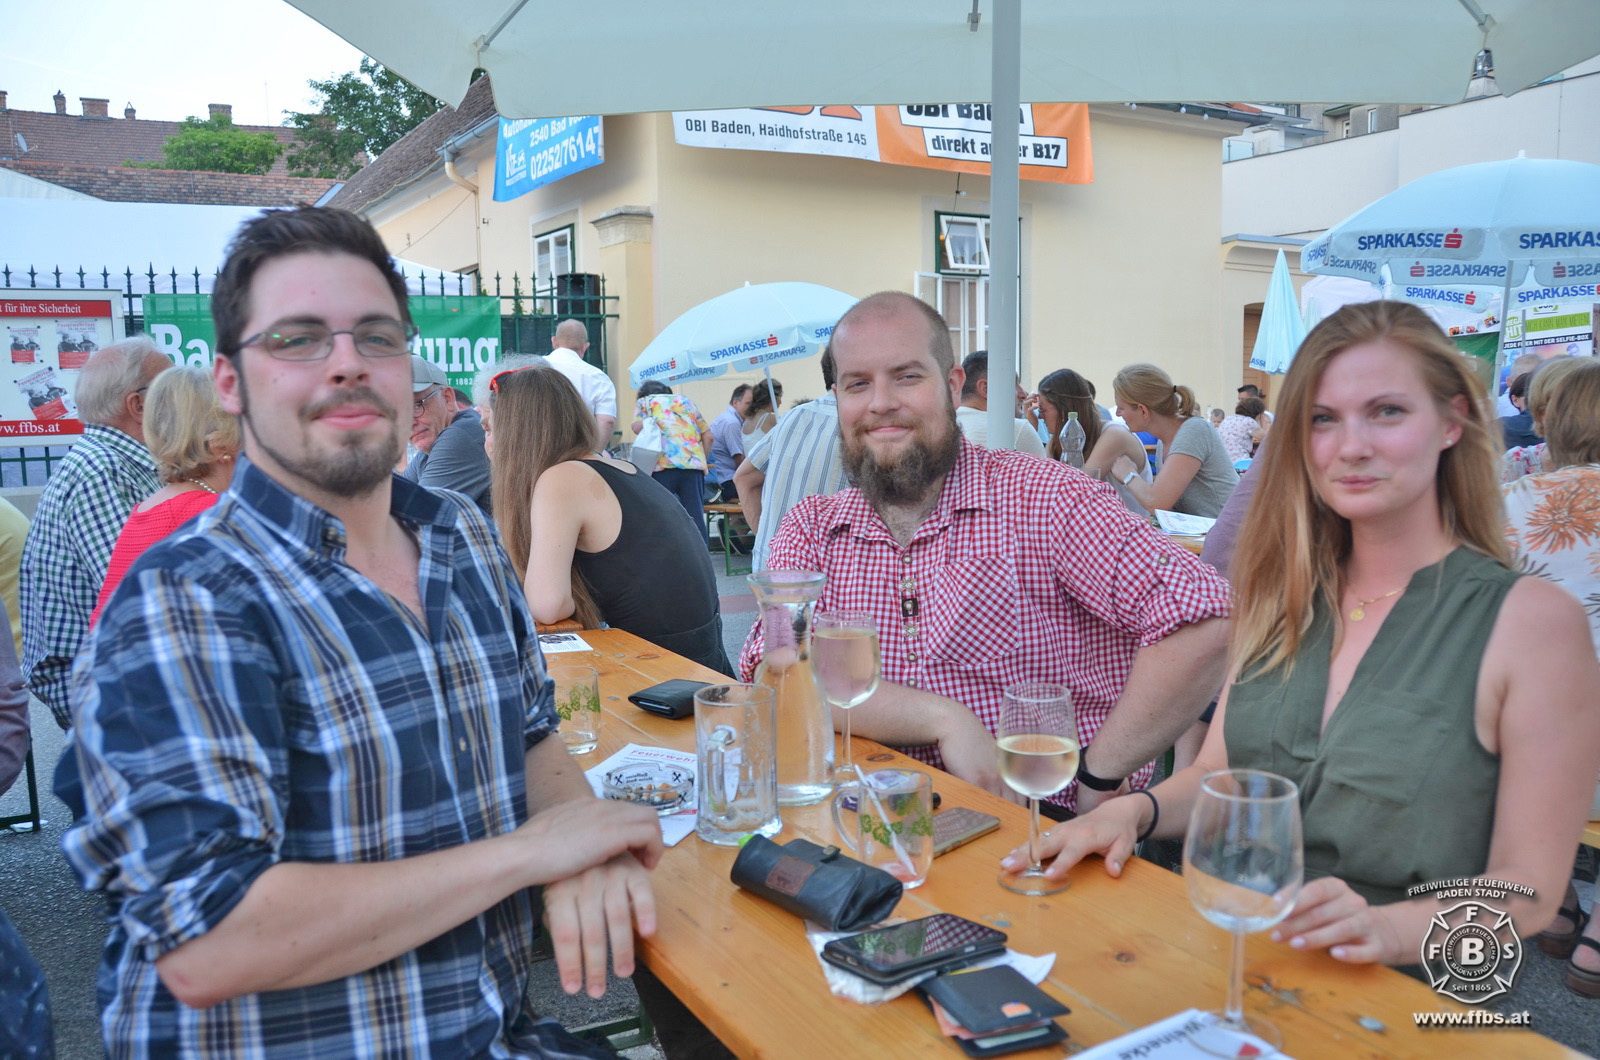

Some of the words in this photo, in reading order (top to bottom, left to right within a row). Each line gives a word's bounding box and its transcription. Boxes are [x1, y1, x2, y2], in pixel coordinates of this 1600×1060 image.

[530, 124, 549, 148] 2540
[551, 117, 567, 137] Bad
[685, 118, 706, 132] OBI
[711, 120, 755, 137] Baden,
[759, 123, 843, 143] Haidhofstraße
[847, 131, 867, 146] 145
[932, 135, 976, 154] direkt
[1032, 143, 1061, 160] B17
[1358, 232, 1444, 250] SPARKASSE
[1406, 286, 1465, 304] SPARKASSE
[1518, 285, 1595, 303] SPARKASSE
[5, 302, 18, 313] für
[20, 303, 37, 313] ihre
[39, 304, 81, 313] Sicherheit
[1505, 325, 1522, 338] HIT
[710, 338, 768, 361] SPARKASSE
[640, 362, 671, 380] SPARKASSE
